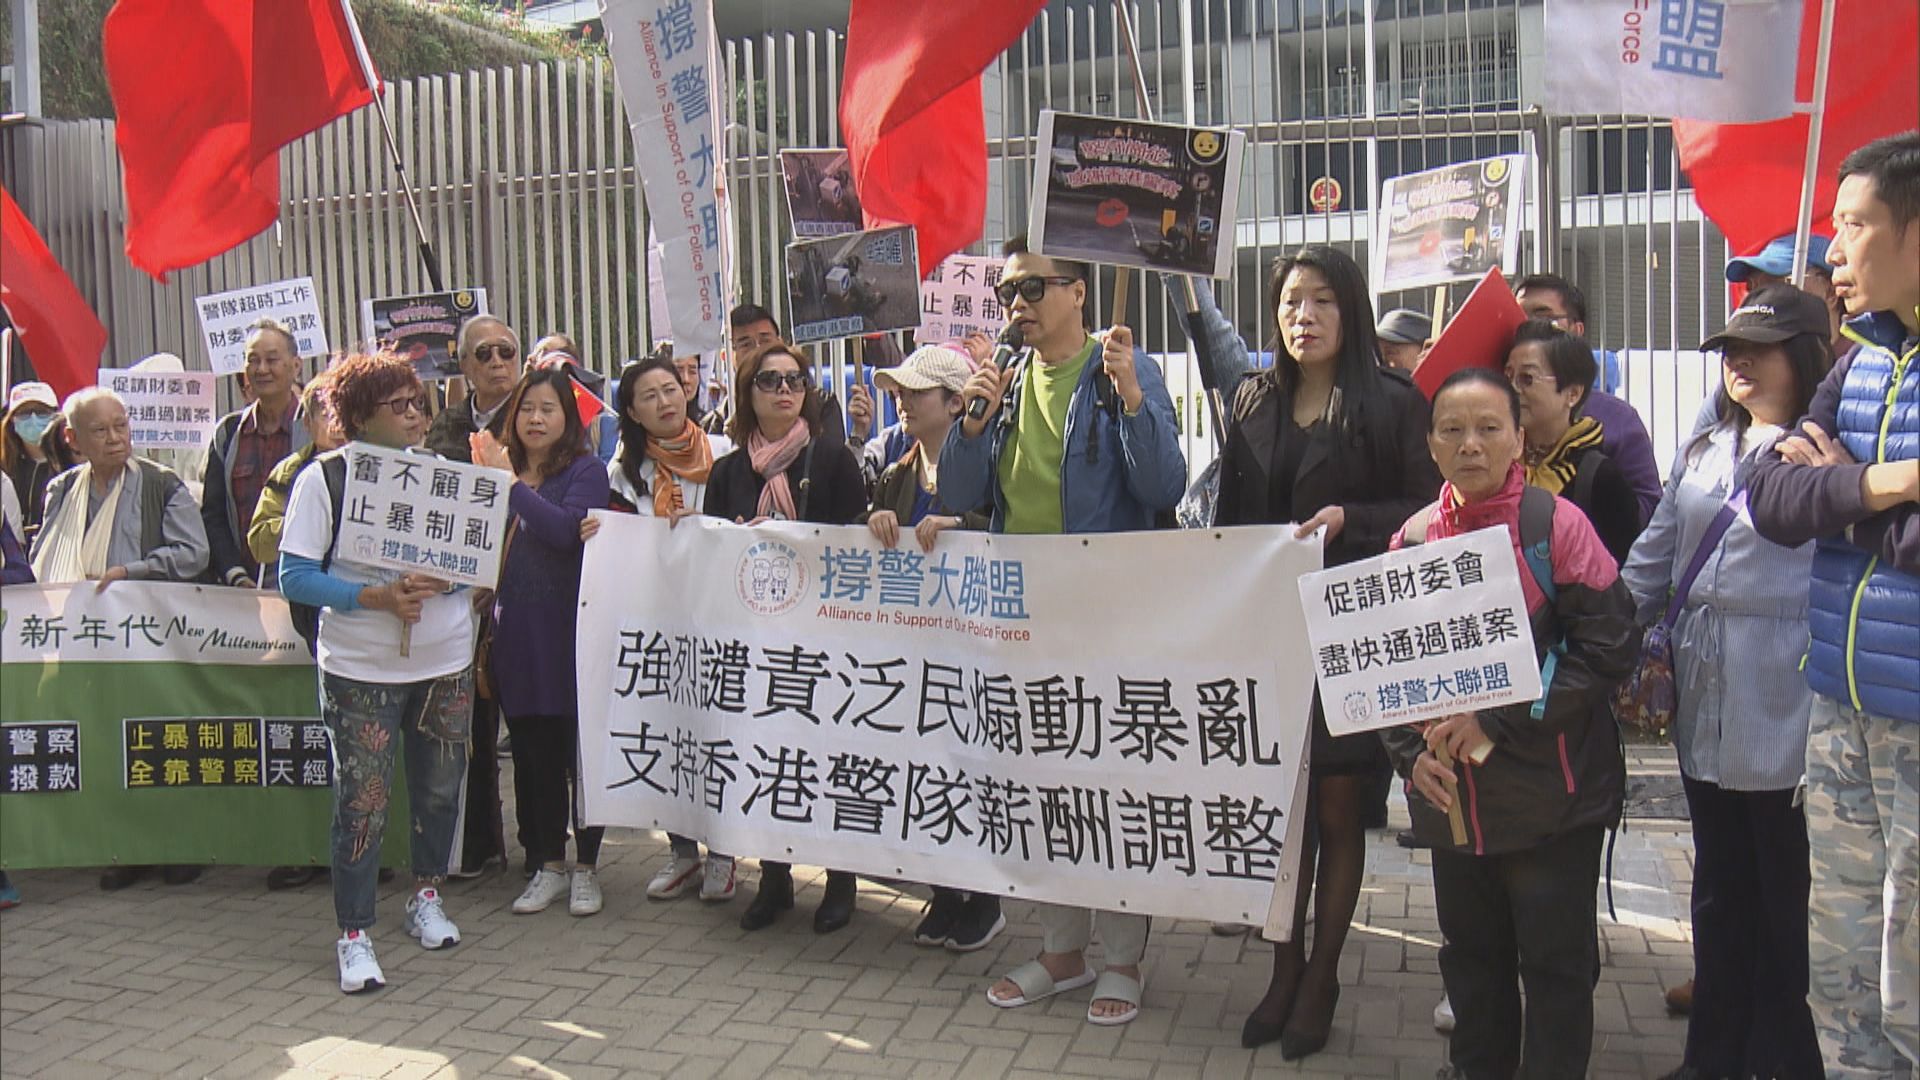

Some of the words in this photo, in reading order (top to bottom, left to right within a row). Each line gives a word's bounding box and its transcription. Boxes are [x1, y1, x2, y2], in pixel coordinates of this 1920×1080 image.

[639, 20, 662, 79] Alliance
[661, 102, 686, 168] Support
[677, 170, 692, 191] of
[681, 191, 695, 219] Our
[688, 224, 703, 271] Police
[202, 285, 311, 320] 警隊超時工作
[697, 276, 711, 321] Force
[112, 376, 201, 395] 促請財委會
[354, 452, 499, 508] 奮不顧身
[347, 494, 492, 551] 止暴制亂
[381, 538, 478, 575] 撐警大聯盟
[819, 546, 1030, 619] 撐警大聯盟
[1323, 550, 1485, 617] 促請財委會
[20, 614, 164, 649] 新年代
[165, 614, 205, 639] New
[198, 628, 296, 653] Millenarian
[817, 604, 872, 622] Alliance
[876, 609, 889, 624] In
[893, 610, 943, 629] Support
[968, 621, 993, 639] Police
[995, 626, 1031, 642] Force
[1319, 607, 1518, 678] 盡快通過議案
[614, 630, 1281, 766] 強烈譴責泛民煽動暴亂
[1377, 662, 1512, 711] 撐警大聯盟
[9, 728, 75, 755] 警察
[130, 722, 258, 750] 止暴制亂
[268, 722, 327, 750] 警察
[10, 762, 77, 791] 撥款
[130, 758, 259, 785] 全靠警察
[269, 758, 328, 786] 天經
[606, 721, 1283, 882] 支持香港警隊薪酬調整
